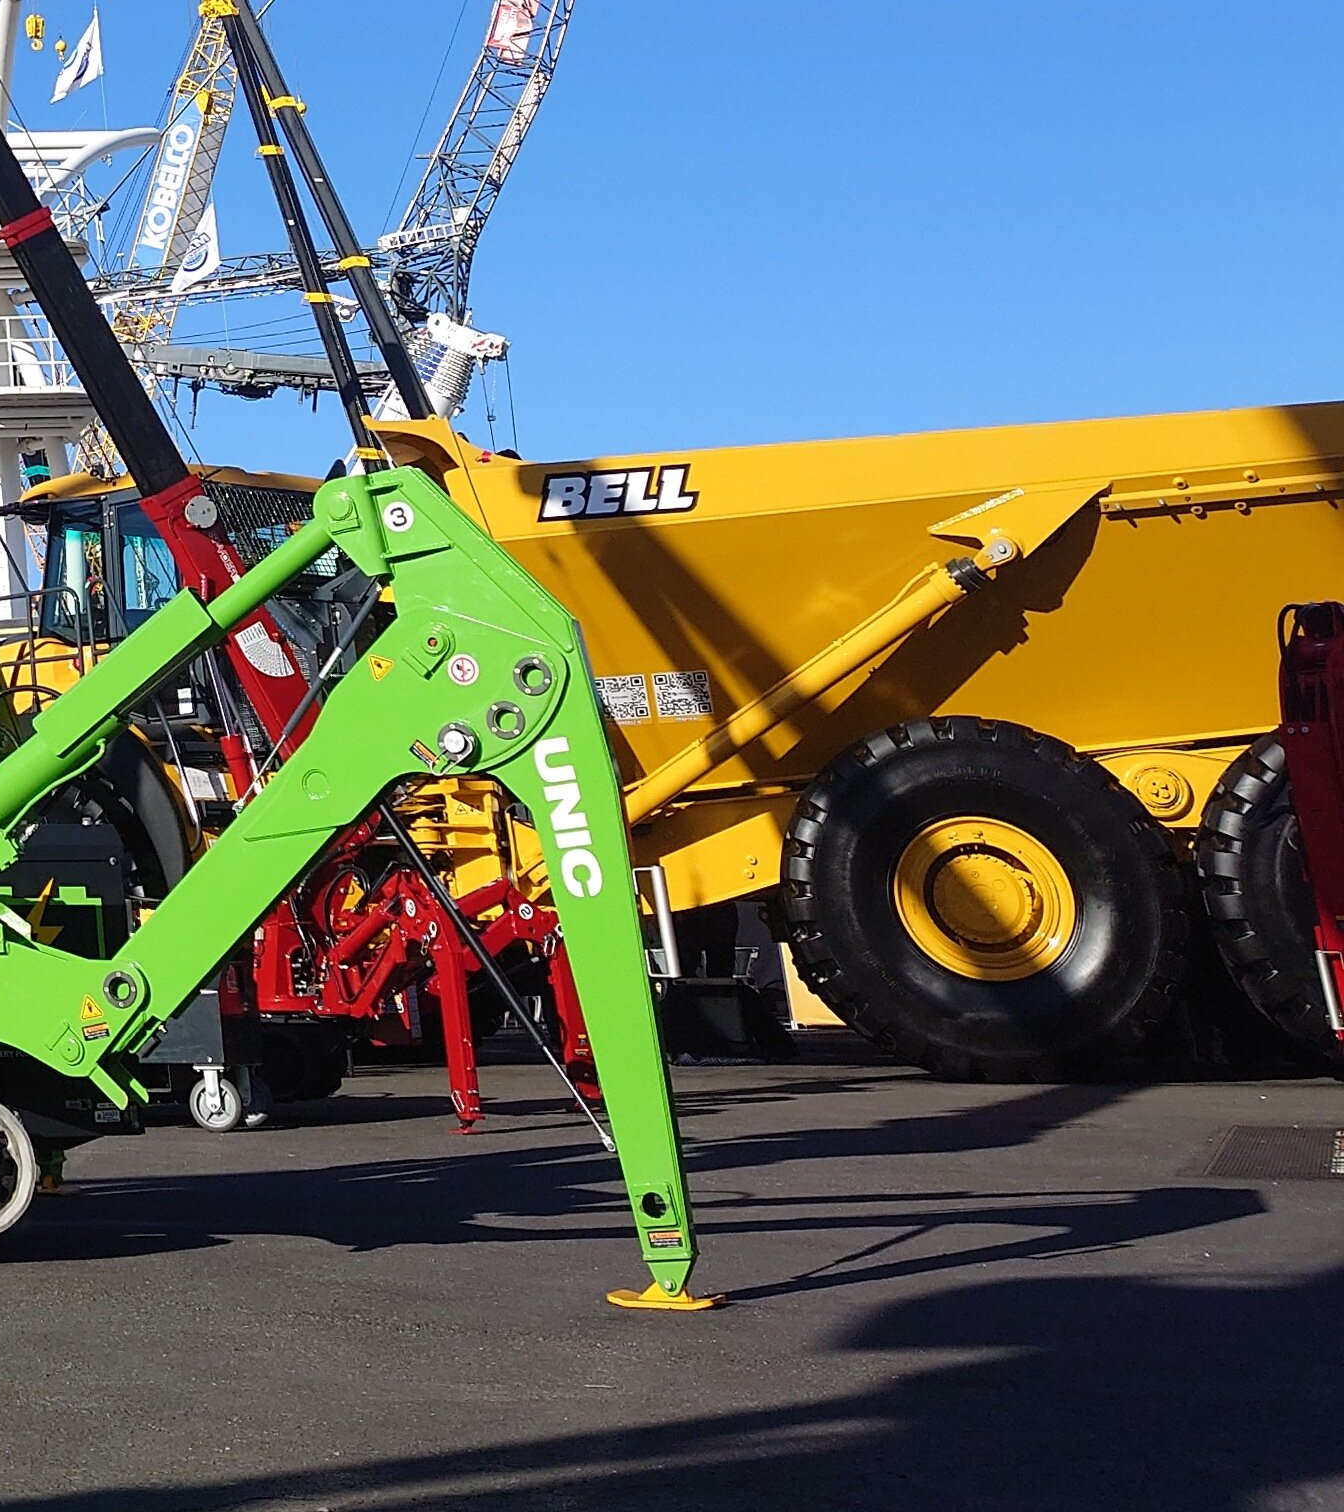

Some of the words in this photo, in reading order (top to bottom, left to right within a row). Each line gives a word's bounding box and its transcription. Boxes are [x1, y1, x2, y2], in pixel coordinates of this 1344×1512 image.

[142, 124, 195, 251] KOBELCO
[390, 508, 407, 527] 3
[543, 468, 697, 518] BELL
[534, 736, 603, 898] UNIC
